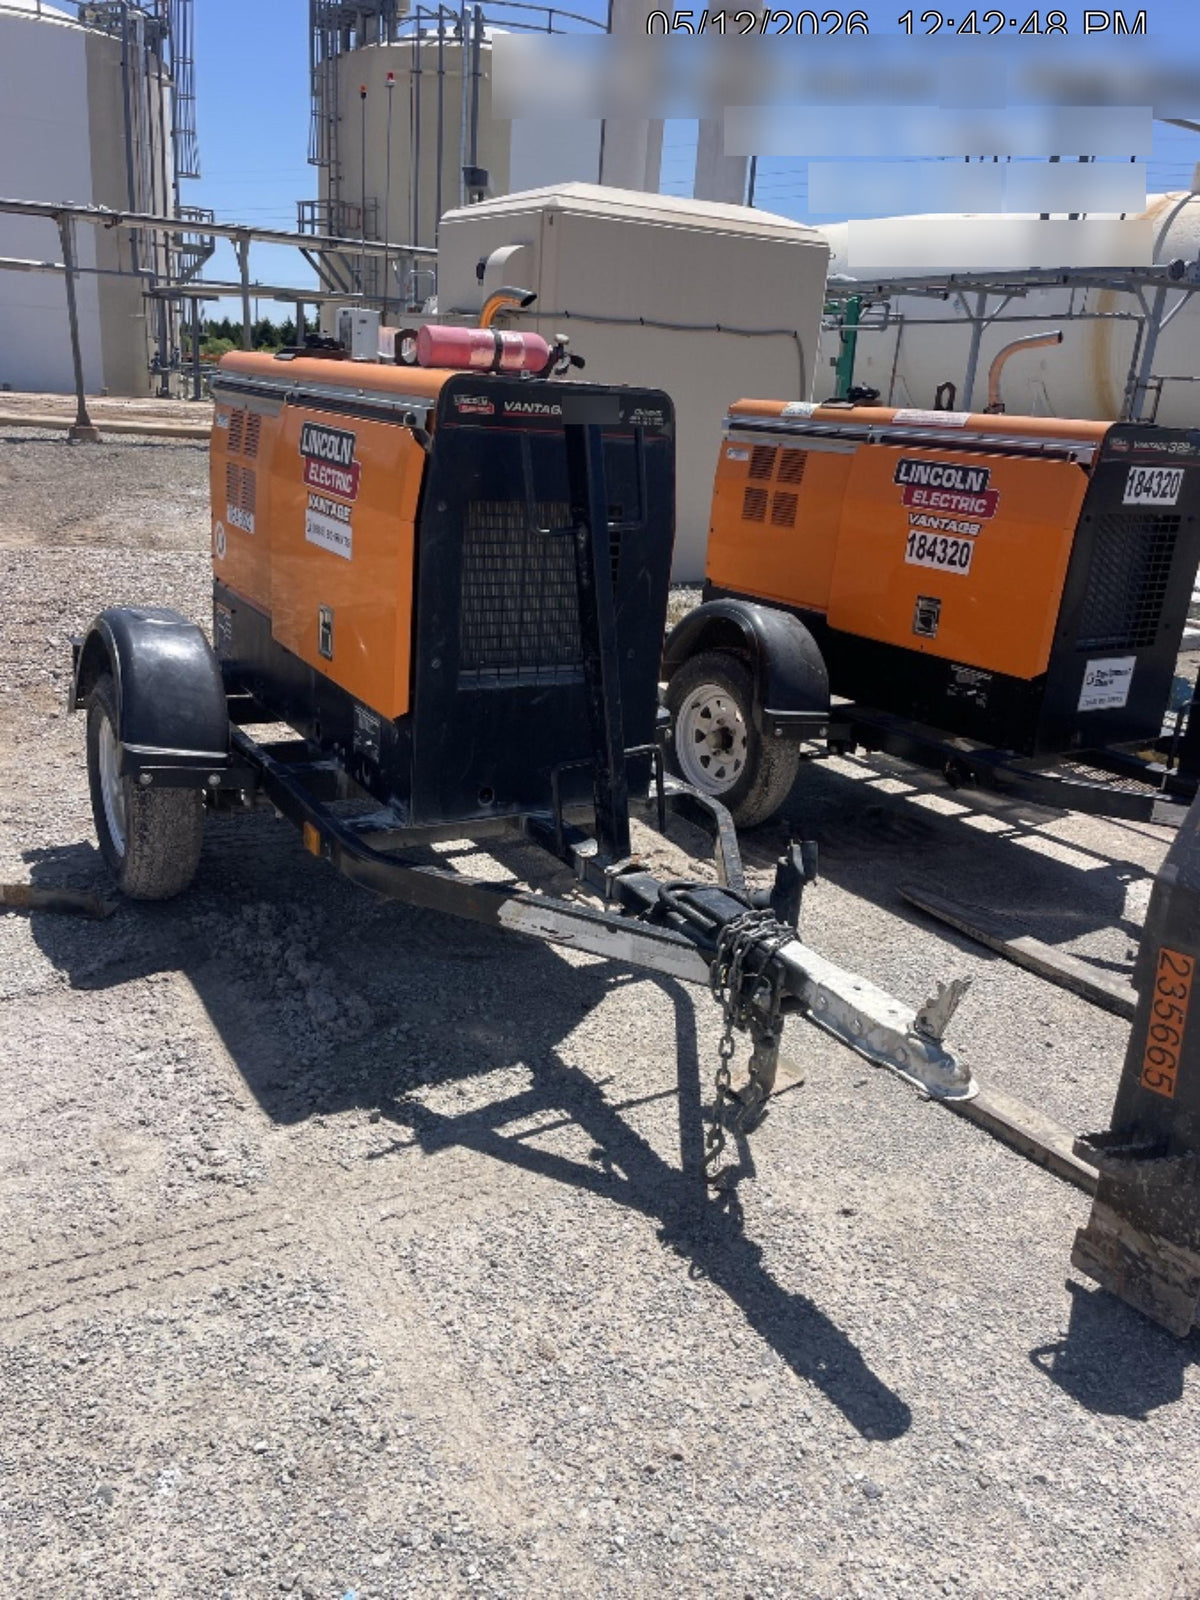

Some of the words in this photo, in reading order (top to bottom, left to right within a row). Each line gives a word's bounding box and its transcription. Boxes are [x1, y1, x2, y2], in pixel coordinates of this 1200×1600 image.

[503, 401, 562, 415] VANTAG
[302, 426, 355, 466] LINCOLN
[308, 462, 354, 494] ELECTRIC
[899, 463, 985, 492] LINCOLN
[1126, 469, 1180, 498] 184320
[307, 492, 353, 523] VANTAGE
[911, 489, 988, 513] ELECTRIC
[908, 512, 983, 536] VANTAGE
[907, 532, 971, 568] 184320
[1143, 951, 1191, 1093] 235665
